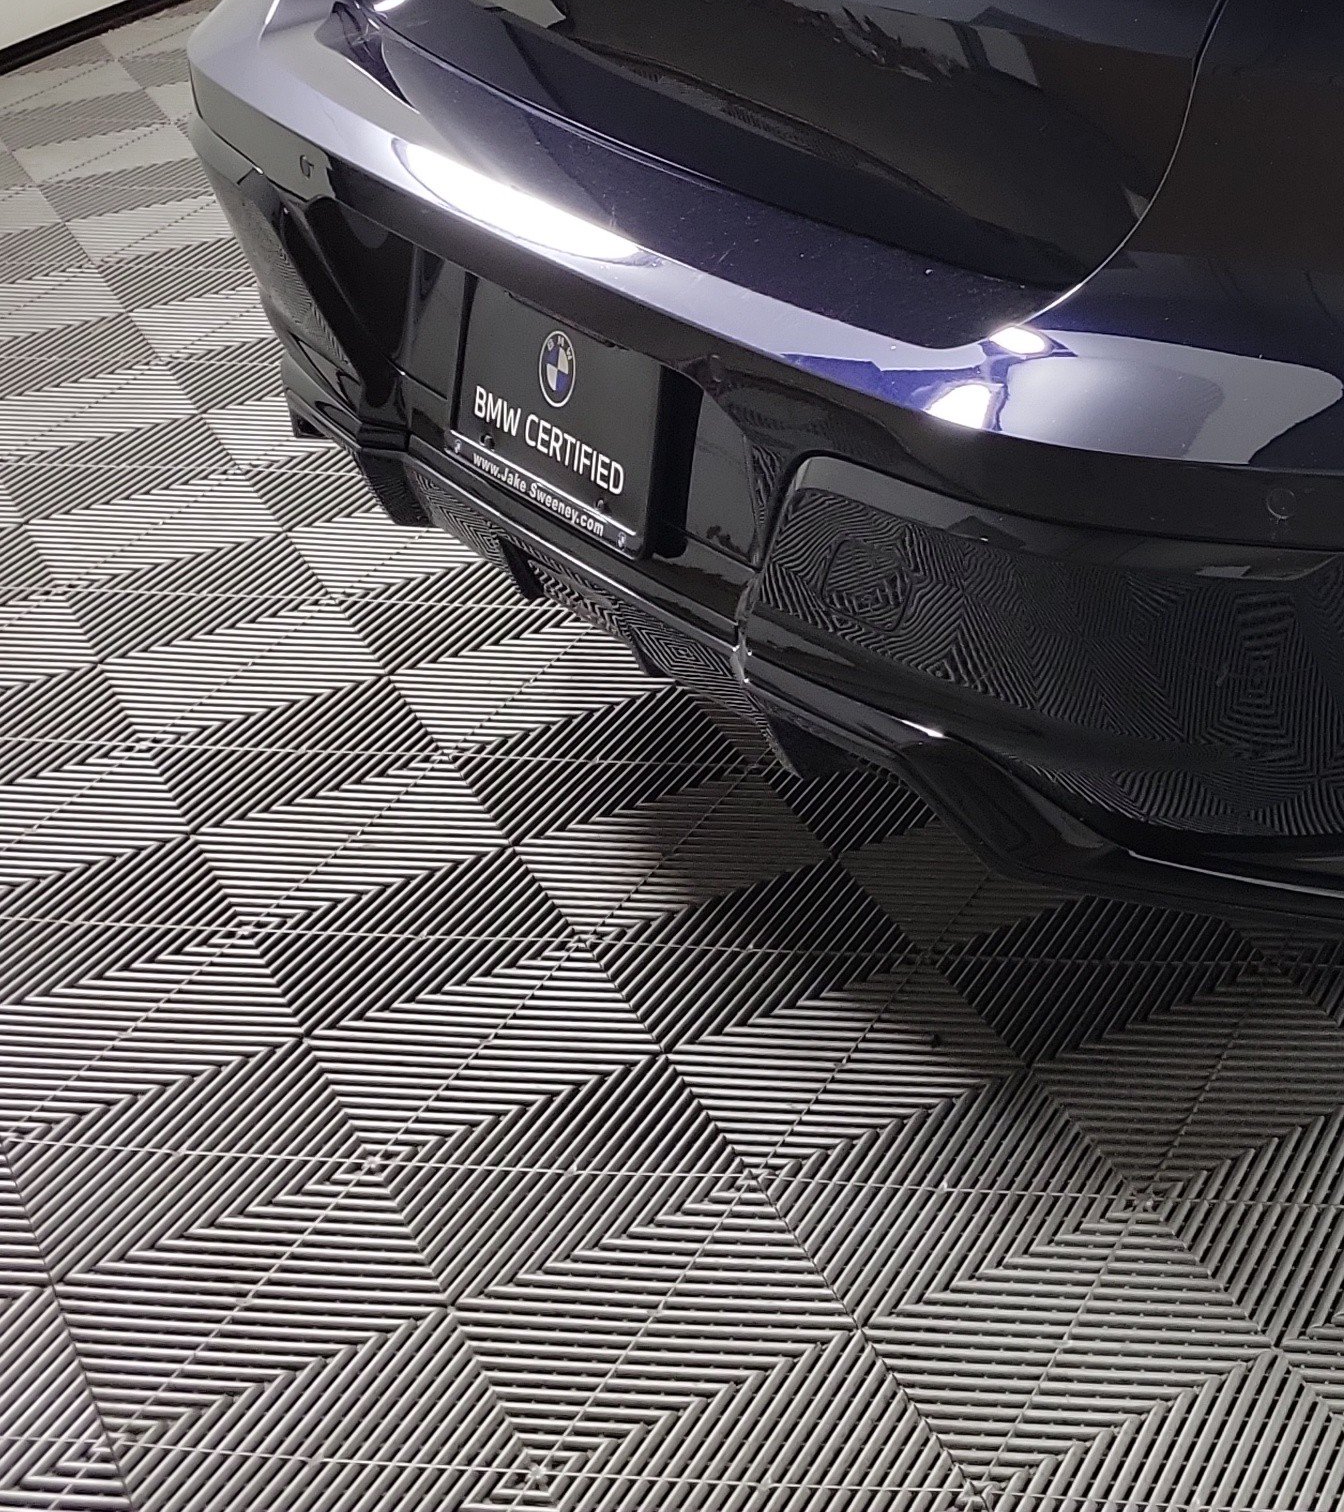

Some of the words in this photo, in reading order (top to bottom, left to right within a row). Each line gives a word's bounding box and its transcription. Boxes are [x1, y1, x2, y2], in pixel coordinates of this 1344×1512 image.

[474, 386, 521, 436] BMW
[525, 413, 624, 495] CERTIFIED
[473, 453, 527, 492] www.Jake
[529, 483, 604, 537] Sweeney.com
